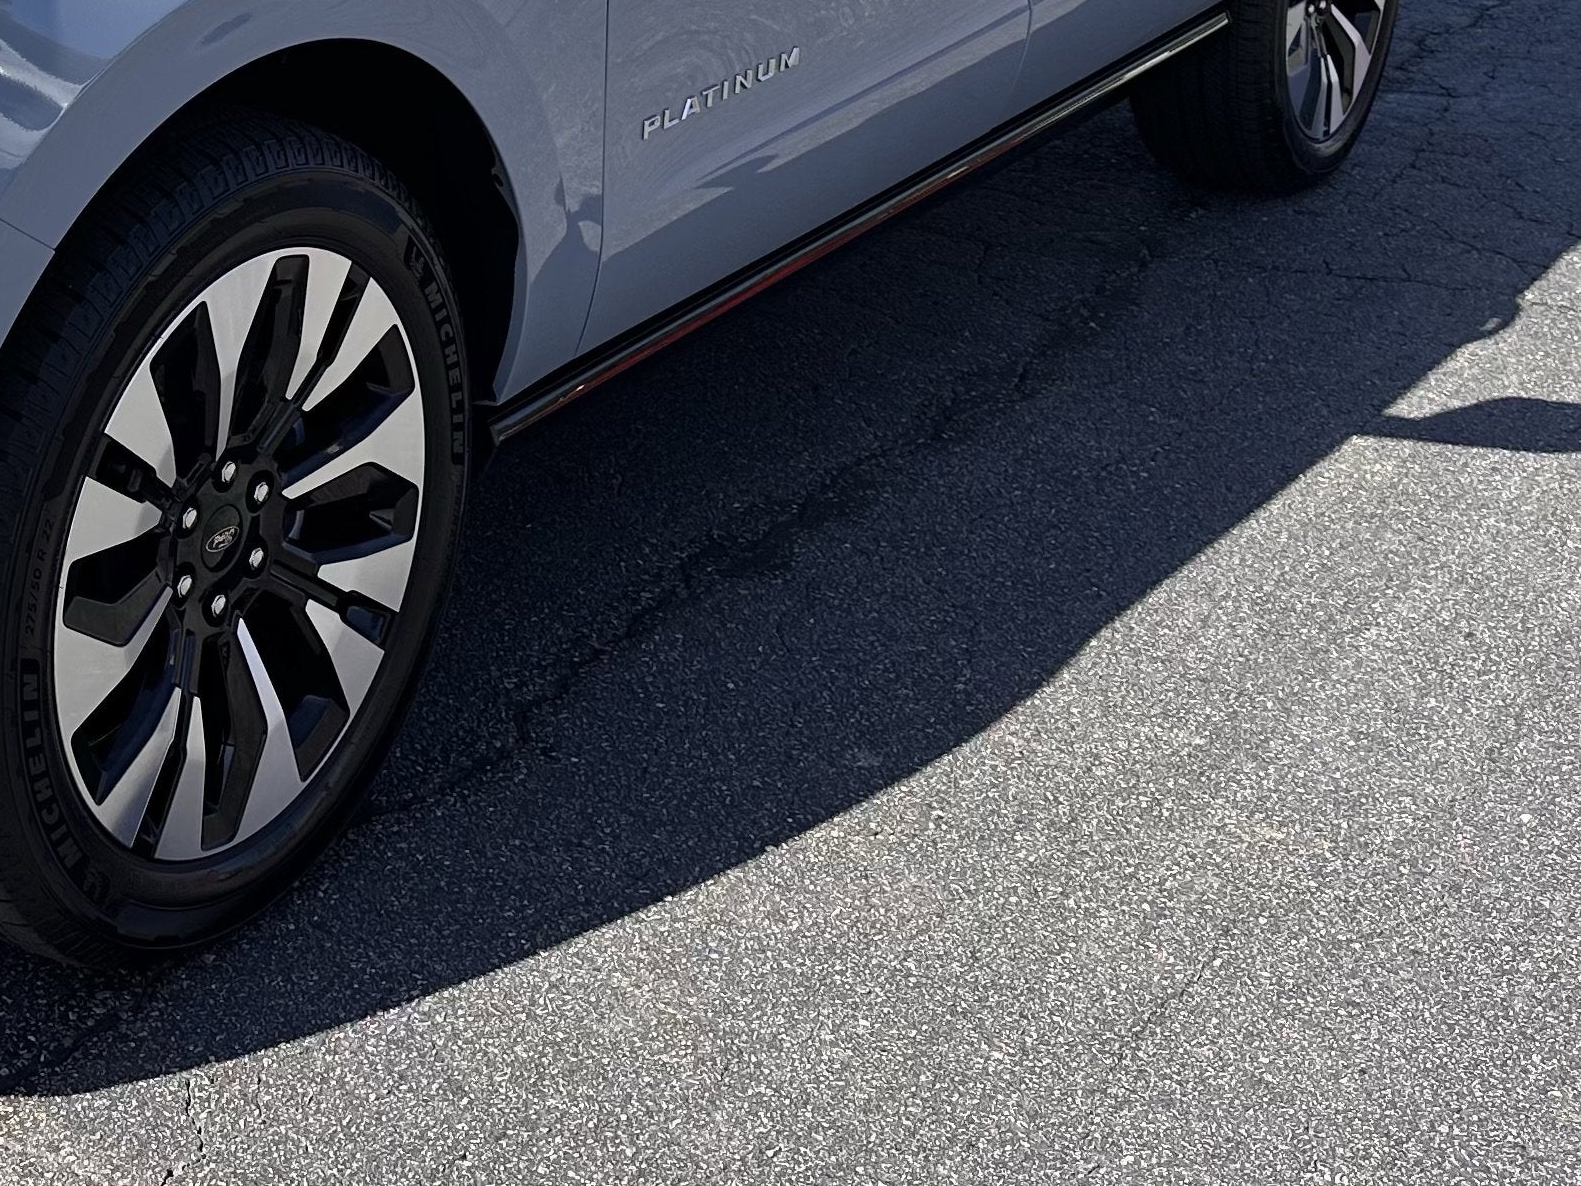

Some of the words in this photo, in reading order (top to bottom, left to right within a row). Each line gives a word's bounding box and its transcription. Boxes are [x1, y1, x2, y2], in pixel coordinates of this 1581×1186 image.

[641, 45, 801, 141] PLATINUM
[423, 279, 466, 455] MICHELIN
[21, 672, 85, 871] MICHELIN
